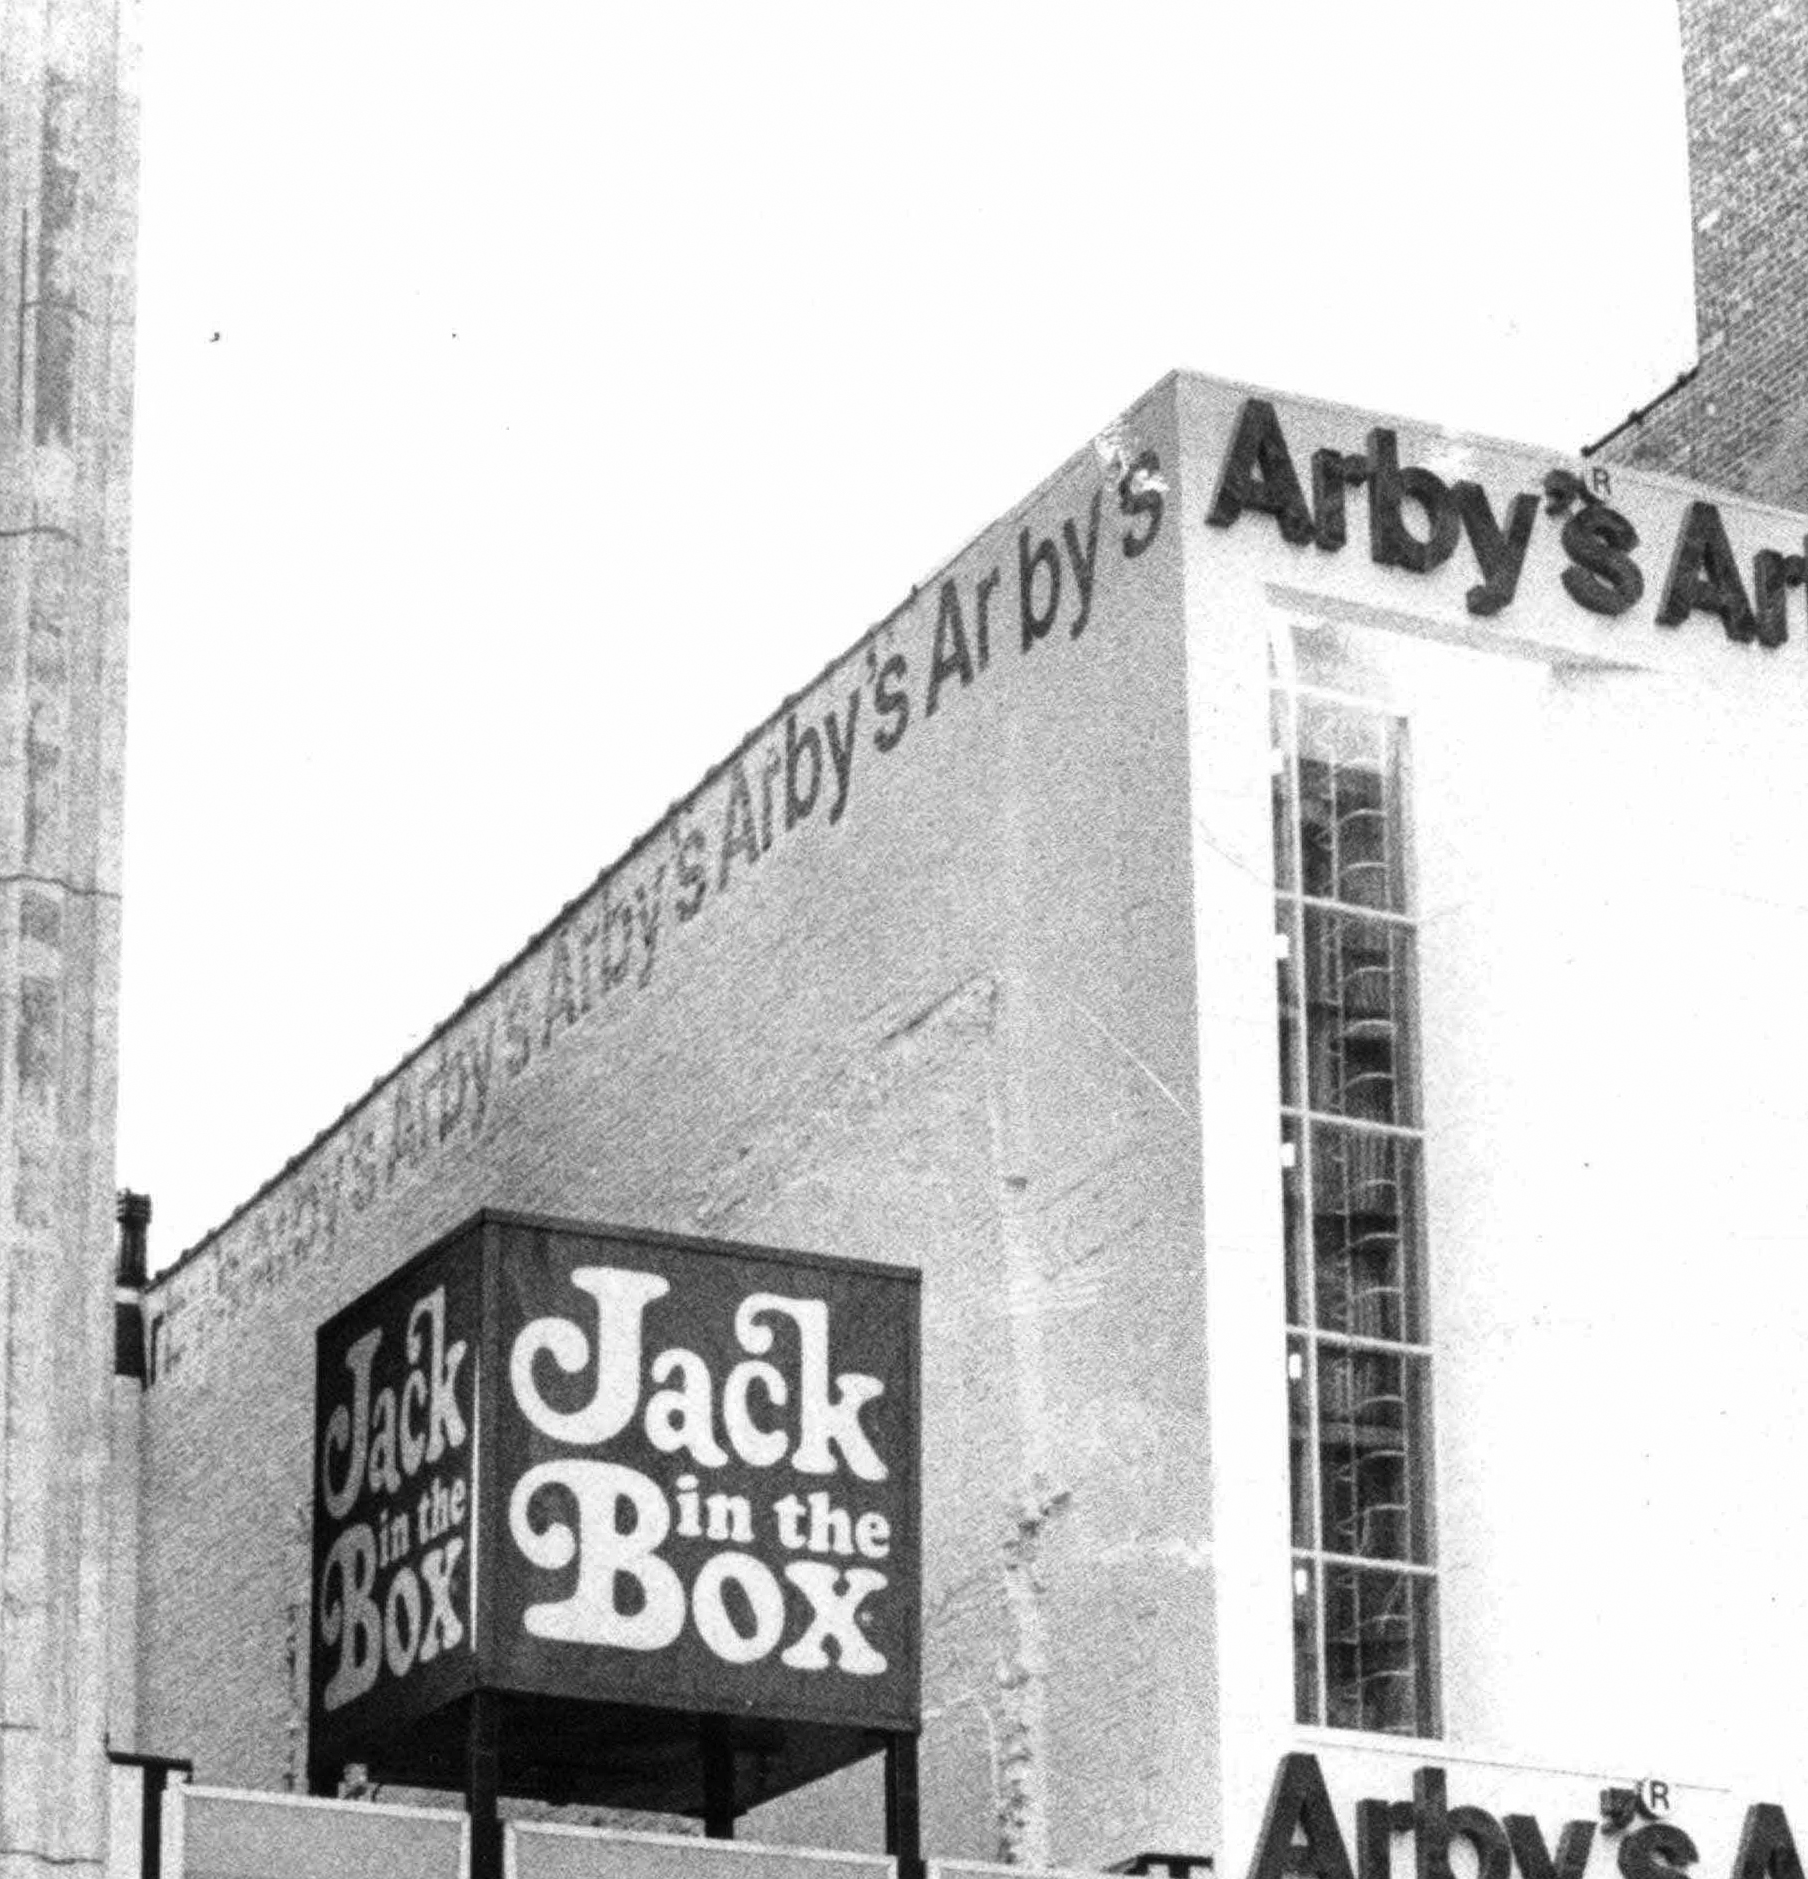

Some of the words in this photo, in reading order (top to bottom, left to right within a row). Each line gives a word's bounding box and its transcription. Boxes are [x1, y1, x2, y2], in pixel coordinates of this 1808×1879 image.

[1205, 398, 1643, 618] Arby's
[542, 822, 707, 1050] Arby's
[718, 644, 910, 891] Arby's
[322, 1286, 468, 1520] Jack
[508, 1266, 888, 1482] Jack
[319, 1525, 466, 1712] Box
[379, 1512, 408, 1564] in
[417, 1478, 467, 1543] the
[508, 1459, 888, 1675] Box
[678, 1475, 754, 1542] in
[776, 1490, 891, 1559] the
